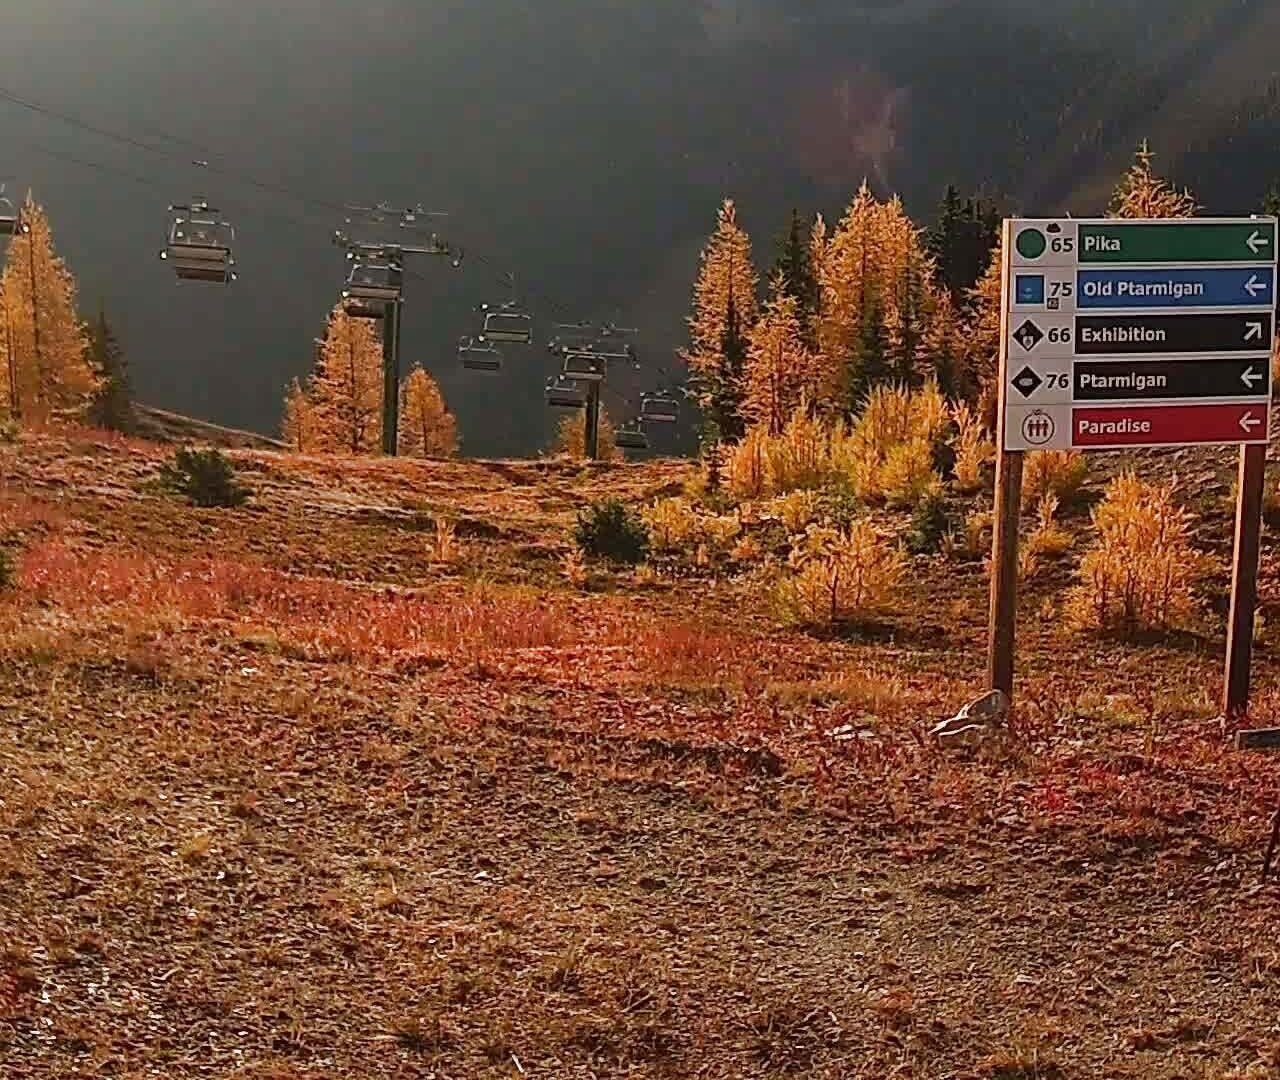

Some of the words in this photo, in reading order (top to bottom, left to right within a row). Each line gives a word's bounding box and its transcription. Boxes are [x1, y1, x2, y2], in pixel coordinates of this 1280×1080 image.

[1051, 237, 1073, 253] 65
[1083, 235, 1121, 252] Pika
[1049, 281, 1073, 297] 75
[1083, 281, 1113, 297] Old
[1117, 280, 1204, 299] Ptarmigan
[1047, 327, 1071, 343] 66
[1081, 326, 1166, 343] Exhibition
[1045, 373, 1069, 389] 76
[1079, 371, 1167, 391] Ptarmigan
[1078, 418, 1152, 436] Paradise
